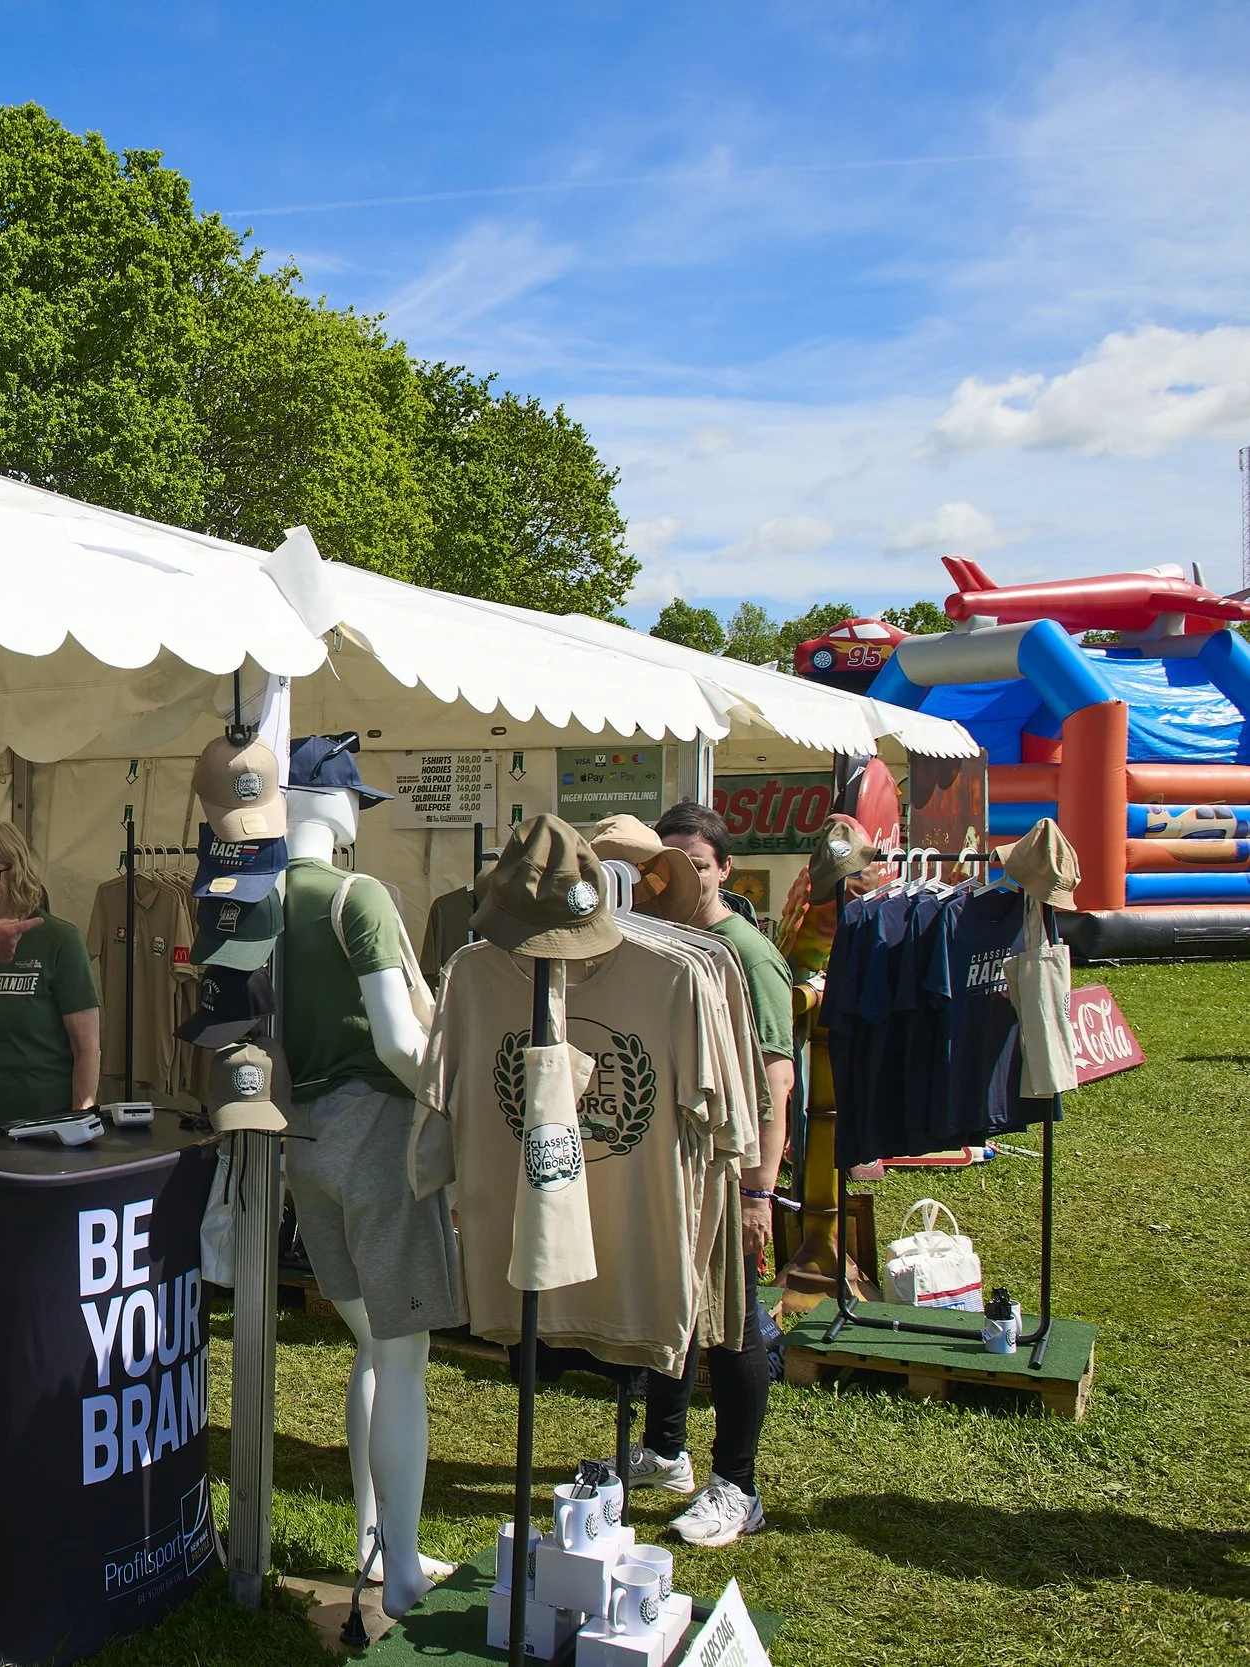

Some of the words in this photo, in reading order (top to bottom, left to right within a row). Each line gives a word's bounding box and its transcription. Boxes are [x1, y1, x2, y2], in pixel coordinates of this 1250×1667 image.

[847, 645, 882, 667] 95
[421, 756, 452, 765] T-SHIRTS
[457, 755, 481, 764] 149,00
[421, 766, 452, 774] HOODIES
[455, 765, 481, 774] 299,00
[432, 775, 452, 783] POLO
[455, 774, 481, 783] 299,00
[587, 773, 605, 783] Pay
[620, 772, 636, 782] Pay
[398, 785, 412, 794] CAP
[456, 784, 481, 793] 149,00
[411, 794, 452, 802] SOLBRILLER
[459, 793, 481, 802] 49,00
[561, 793, 583, 803] INGEN
[583, 791, 658, 802] KONTANTBETALING!
[414, 803, 451, 811] MULEPOSE
[459, 803, 481, 812] 49,00
[750, 836, 822, 849] SERVIC
[210, 842, 243, 858] RACE
[971, 947, 1012, 964] CLASSIC
[531, 1136, 569, 1149] CLASSIC
[531, 1144, 570, 1162] RACE
[533, 1156, 571, 1170] VIBORG
[79, 1198, 153, 1297] BE
[81, 1267, 201, 1388] YOUR
[82, 1344, 208, 1486] BRAND
[105, 1531, 182, 1592] Profilsport
[137, 1592, 146, 1605] BE
[148, 1582, 166, 1599] YOUR
[715, 1612, 735, 1651] DAG
